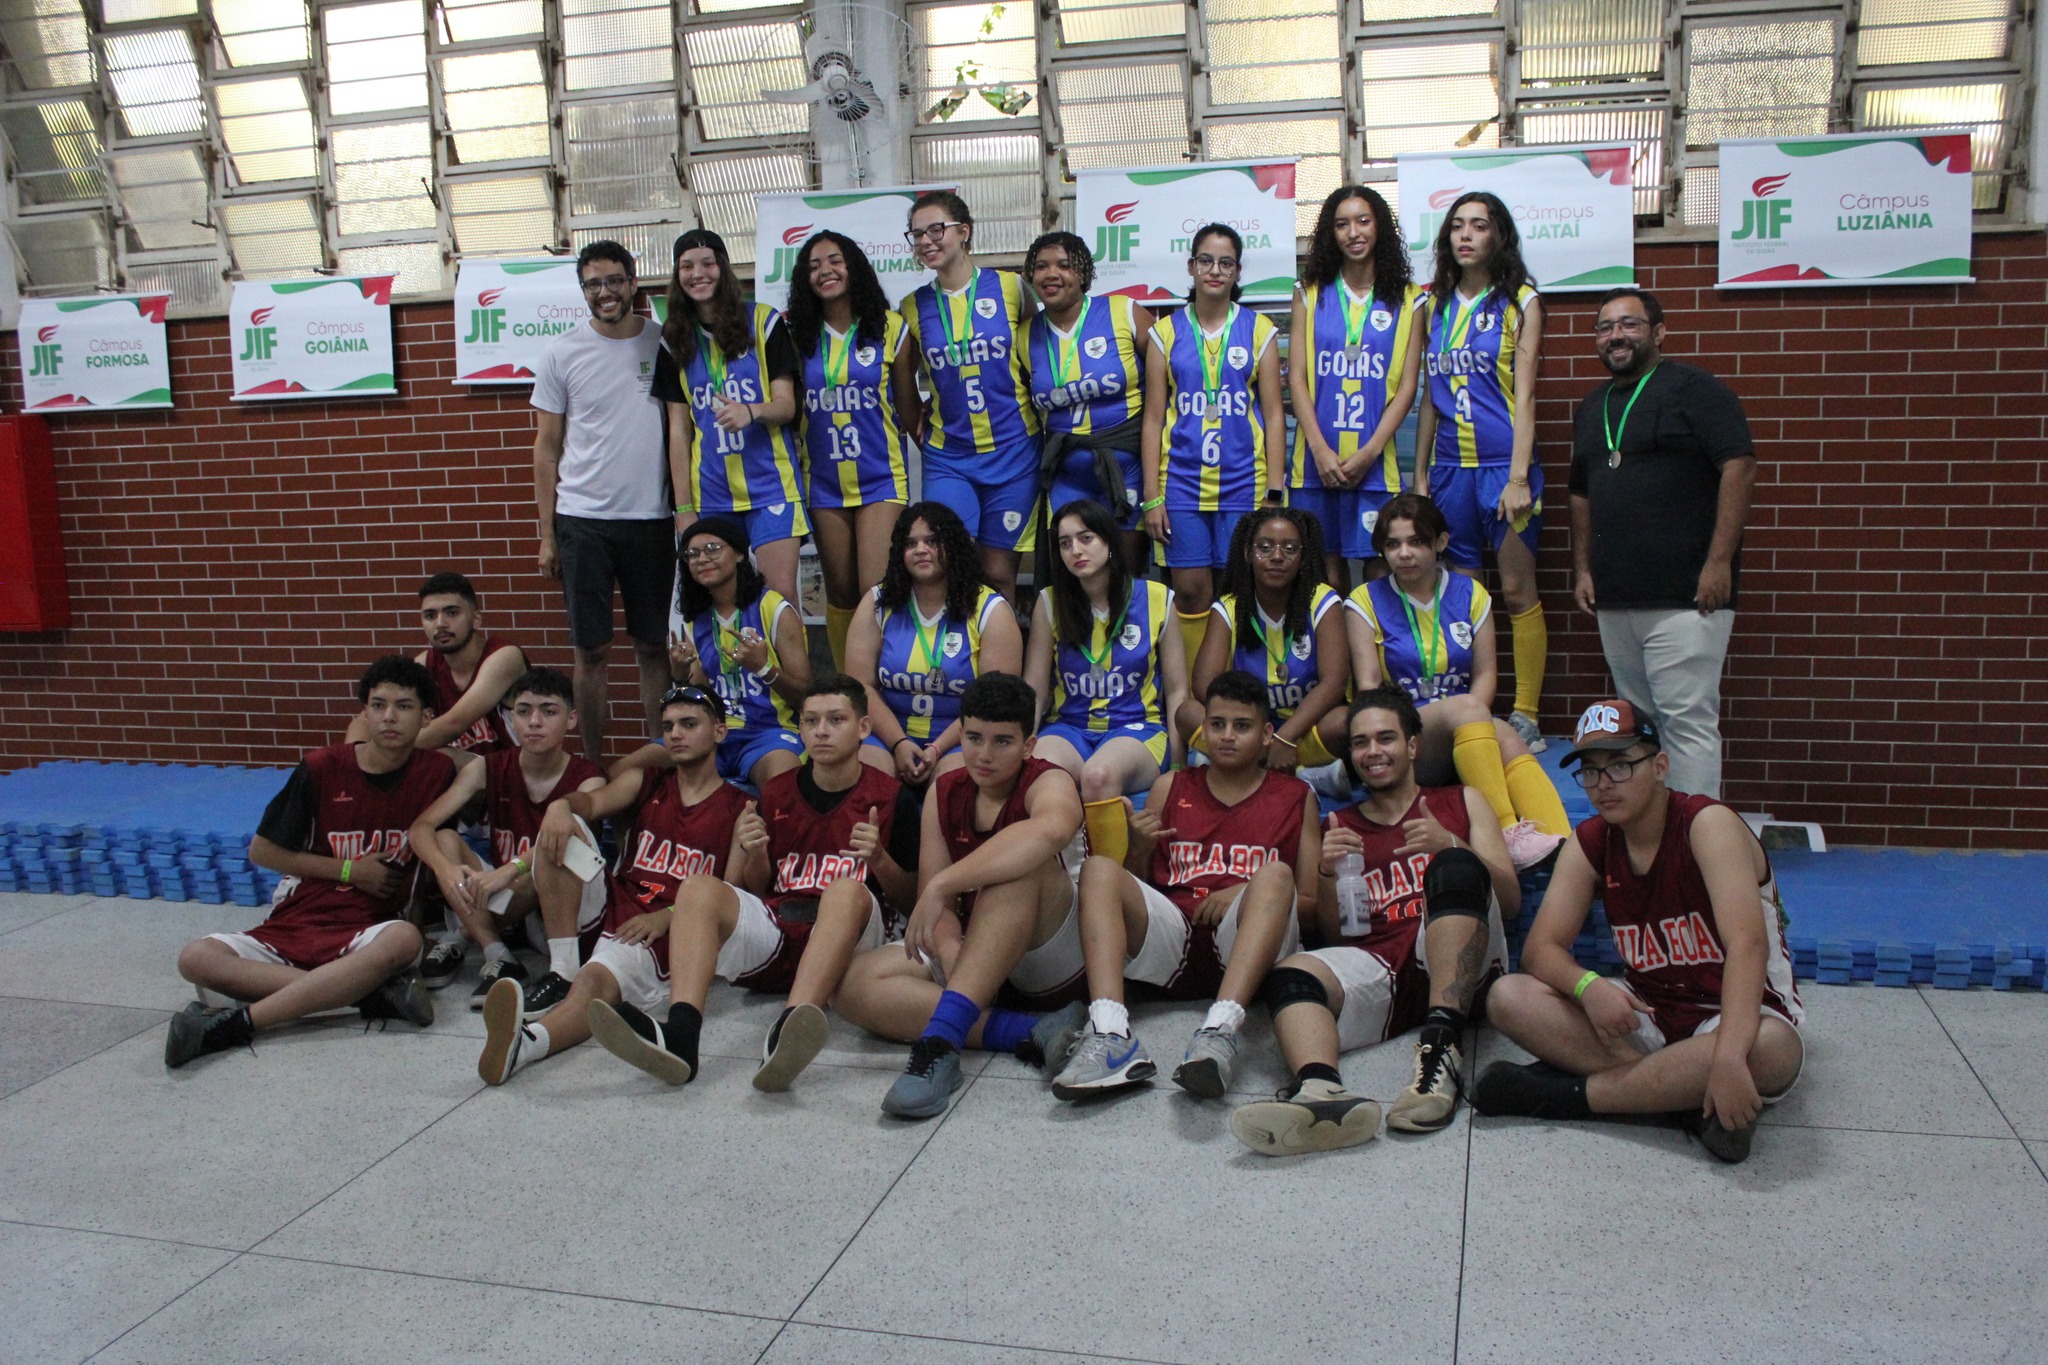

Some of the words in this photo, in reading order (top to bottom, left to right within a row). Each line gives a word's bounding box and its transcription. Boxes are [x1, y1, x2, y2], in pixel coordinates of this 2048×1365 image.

[1513, 205, 1594, 222] Câmpus
[1839, 194, 1929, 212] Câmpus
[1526, 219, 1580, 240] JATAÍ
[1731, 199, 1792, 240] JIF
[1837, 211, 1933, 231] LUZIÂNIA
[537, 303, 592, 321] Câmpu
[306, 321, 365, 338] Câmpus
[464, 308, 506, 343] JIF
[89, 338, 143, 353] Câmpus
[239, 326, 278, 360] JIF
[305, 334, 369, 354] GOIÂNIA
[29, 344, 63, 377] JIF
[86, 352, 149, 369] FORMOSA
[806, 380, 878, 412] GOIÁS
[965, 378, 985, 411] 5
[1333, 393, 1365, 429] 12
[827, 426, 861, 460] 13
[1201, 431, 1220, 465] 6
[912, 694, 934, 717] 9
